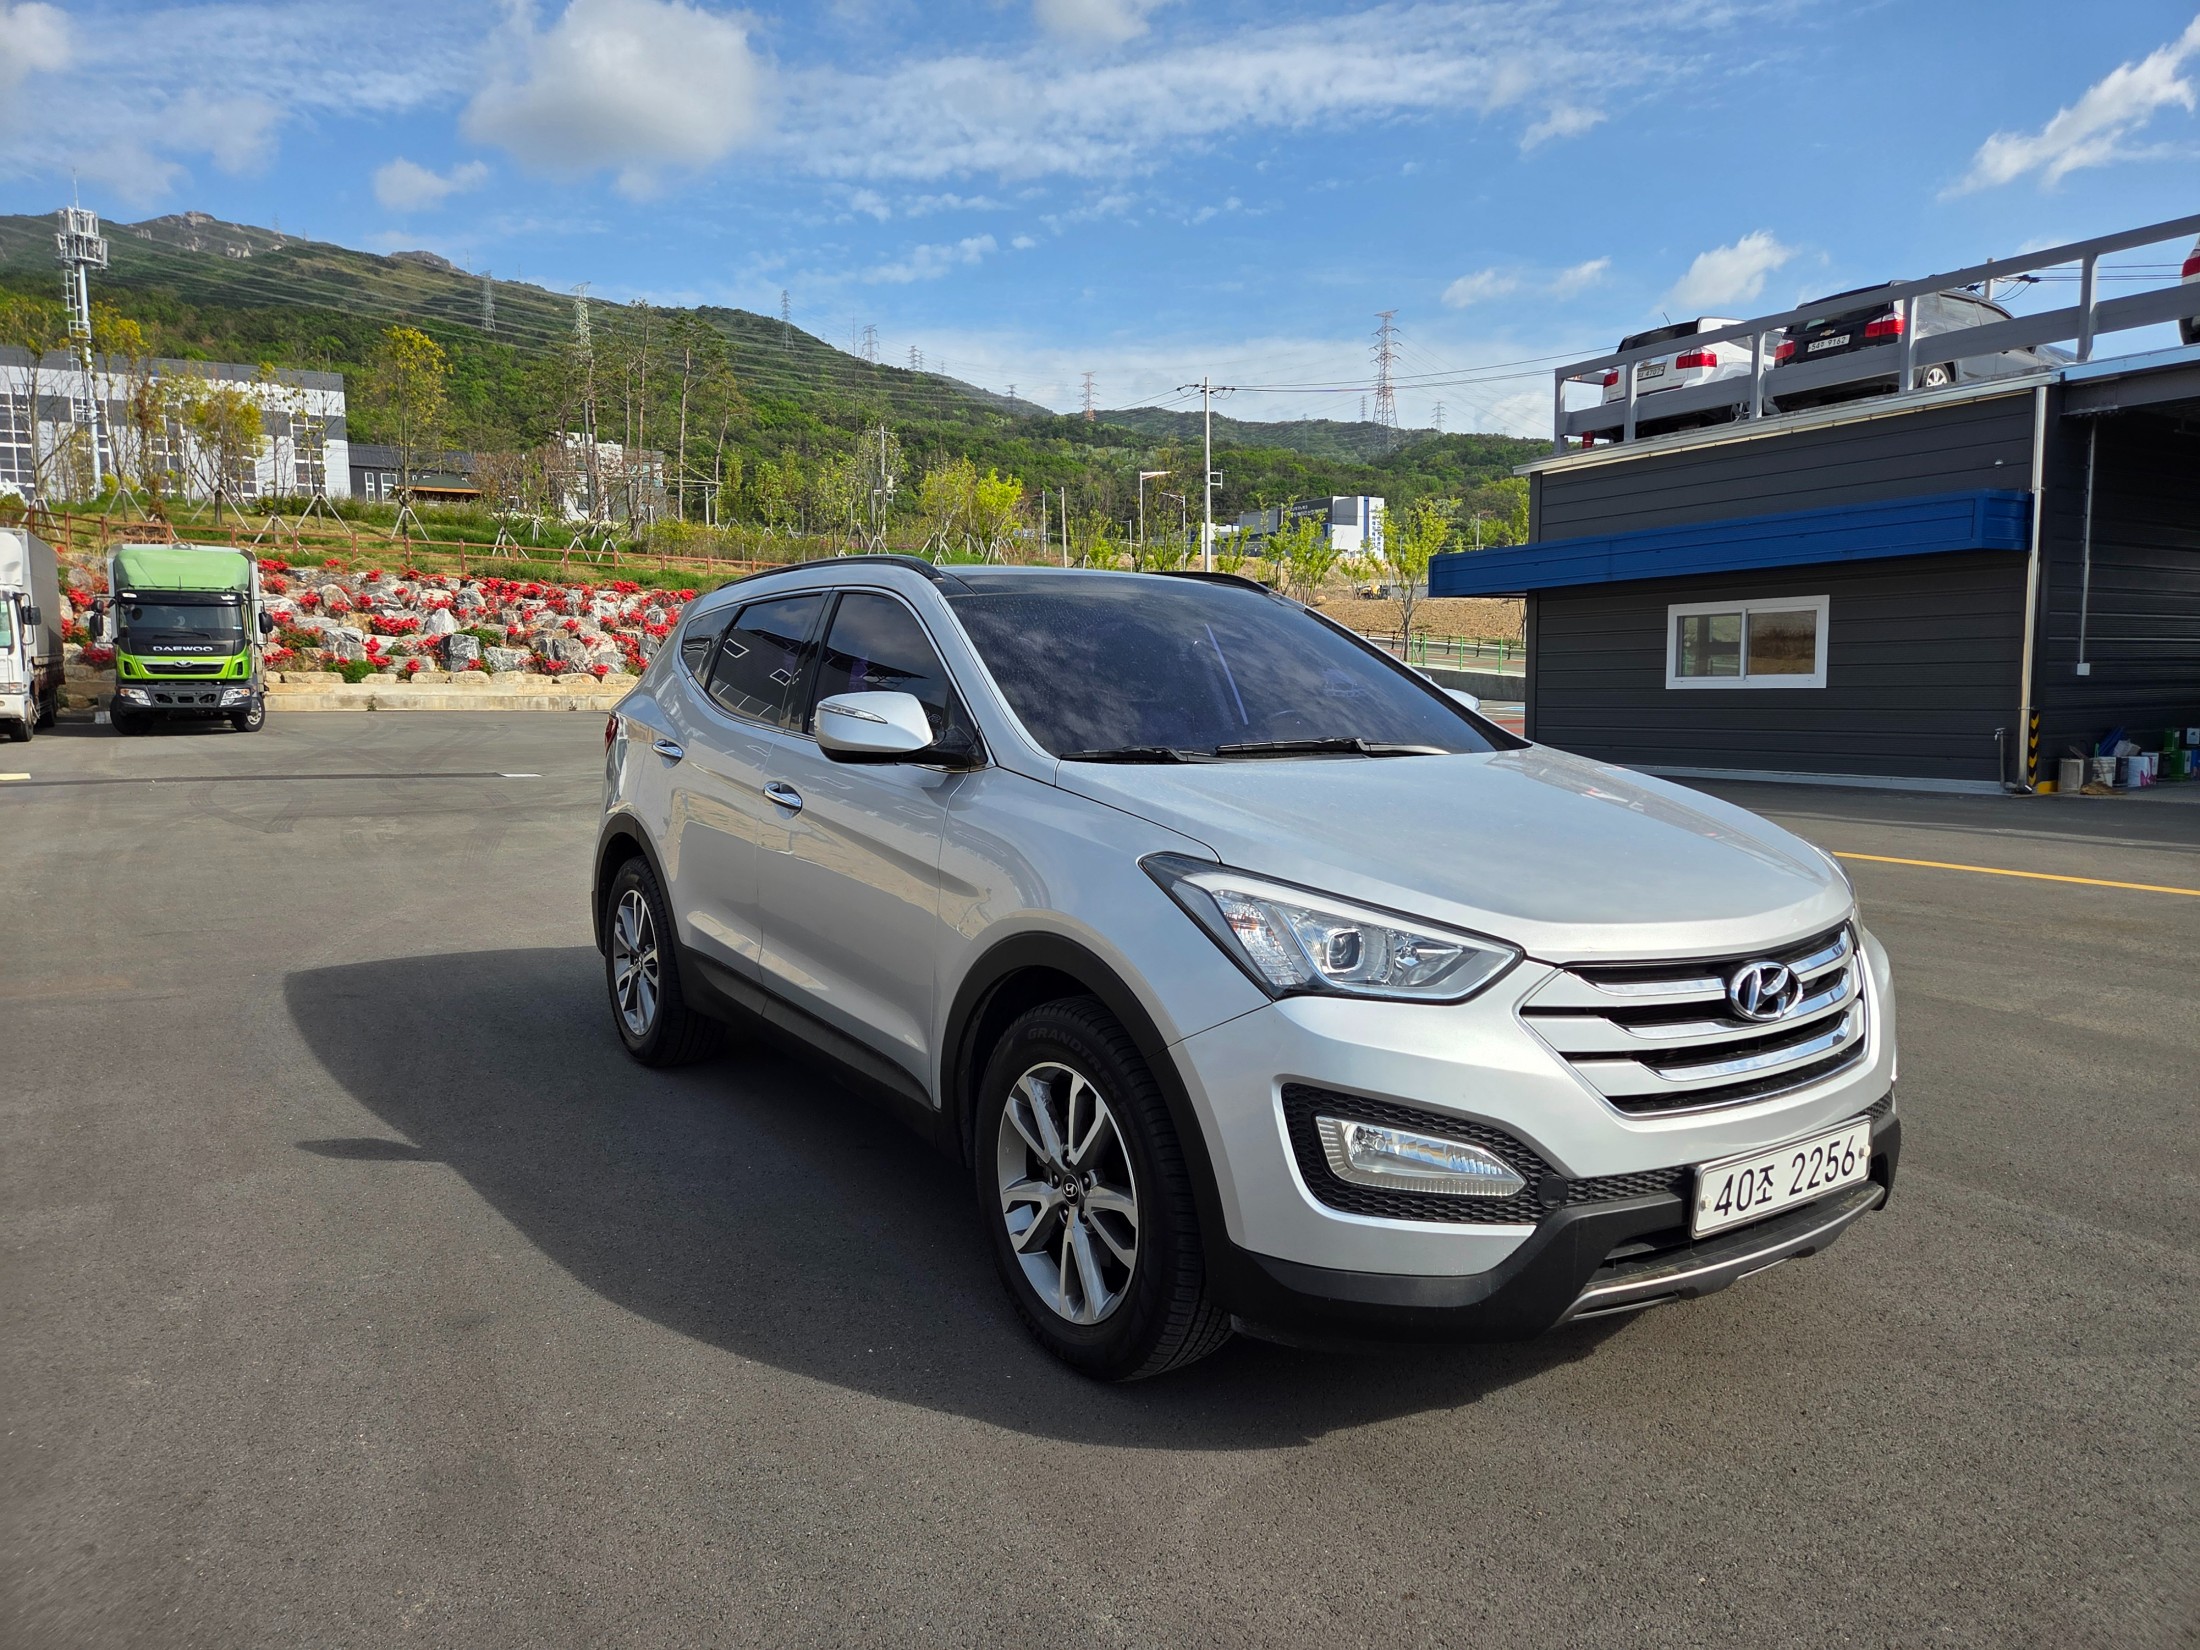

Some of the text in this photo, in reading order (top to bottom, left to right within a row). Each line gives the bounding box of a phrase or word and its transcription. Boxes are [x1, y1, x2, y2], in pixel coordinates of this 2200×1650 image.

[1827, 336, 1847, 347] 9162
[1713, 1134, 1856, 1217] 40조 2256
